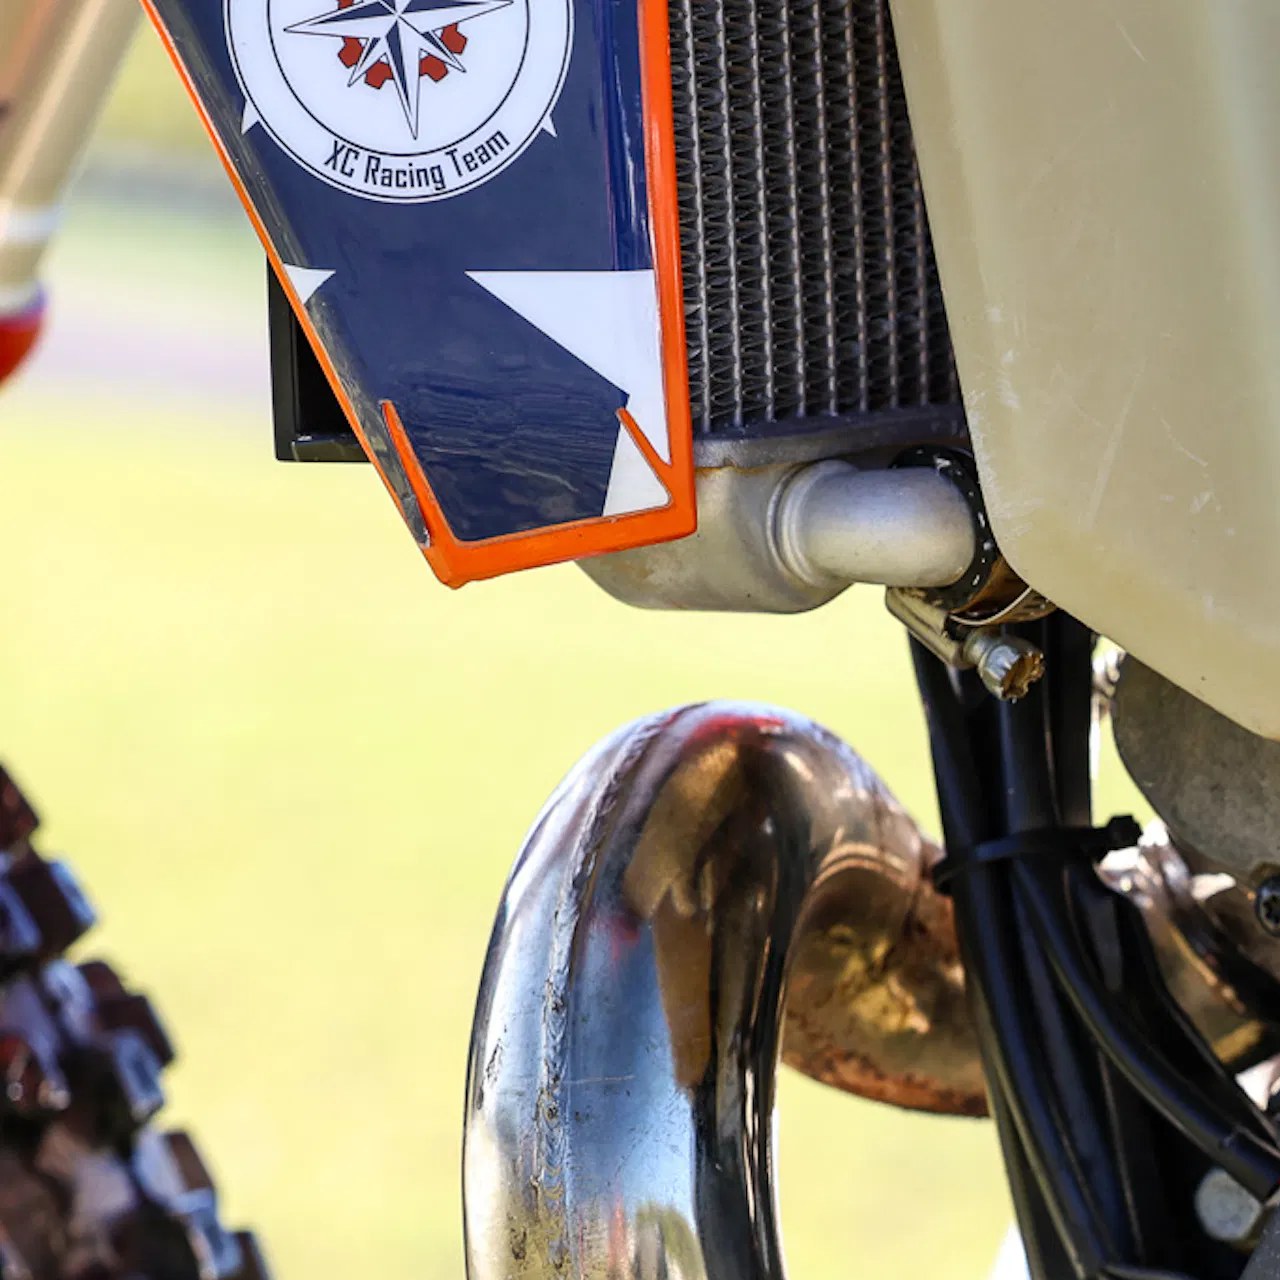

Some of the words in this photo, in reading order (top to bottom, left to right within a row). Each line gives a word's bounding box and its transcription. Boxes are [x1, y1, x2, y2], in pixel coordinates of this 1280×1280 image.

[324, 140, 360, 178] XC
[364, 155, 446, 191] Racing
[445, 130, 511, 177] Team
